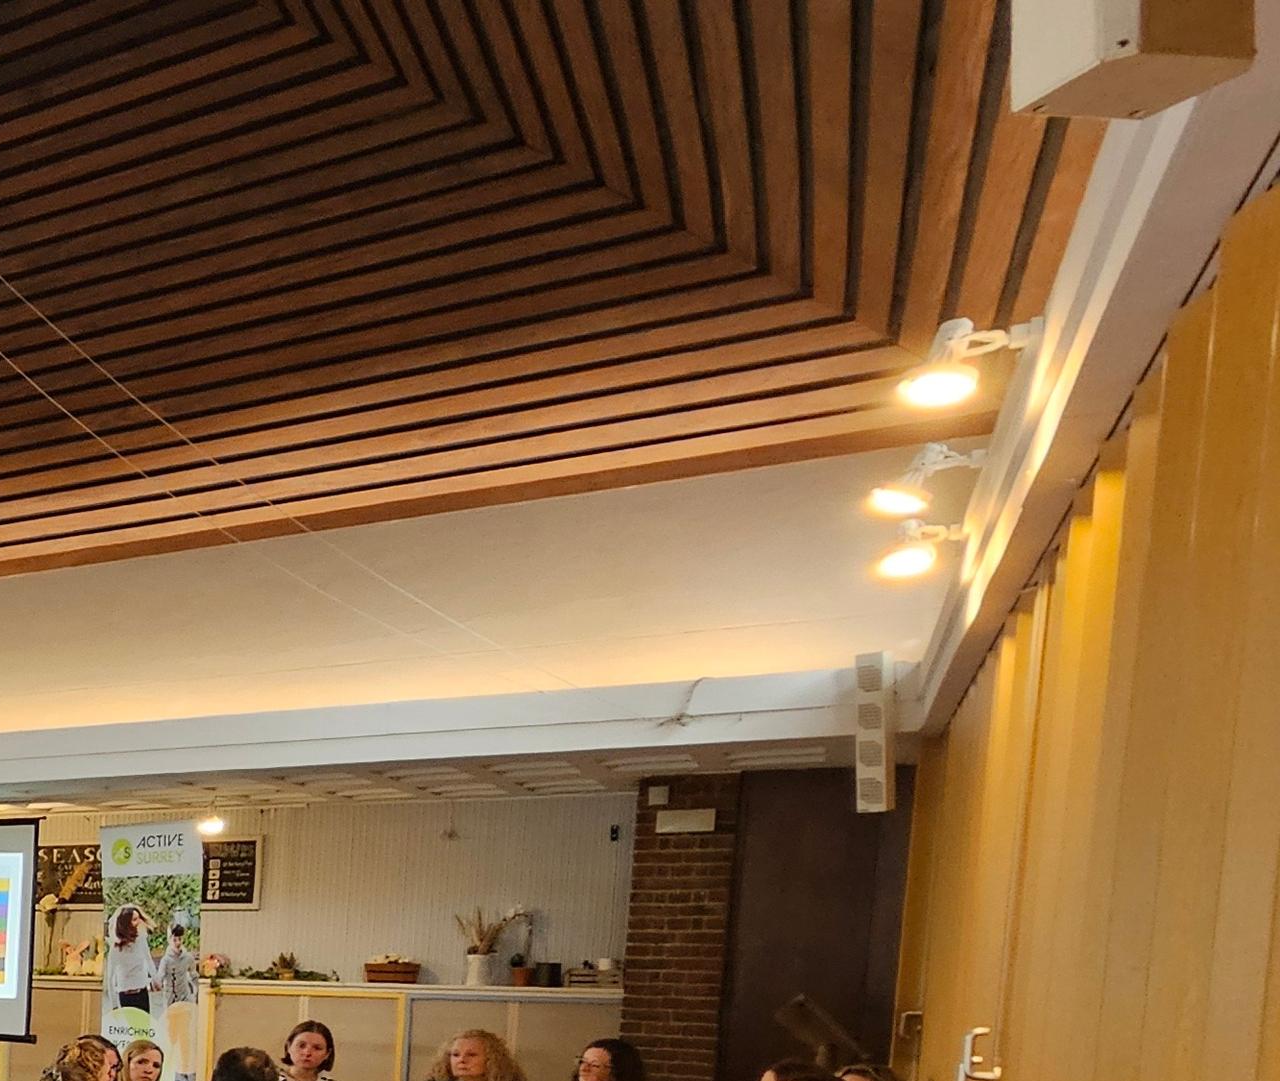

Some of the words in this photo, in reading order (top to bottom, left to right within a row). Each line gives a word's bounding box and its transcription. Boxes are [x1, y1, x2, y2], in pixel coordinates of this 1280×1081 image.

[136, 833, 184, 849] ACTIVE
[136, 848, 184, 865] SURREY
[108, 1025, 156, 1038] ENRICHING
